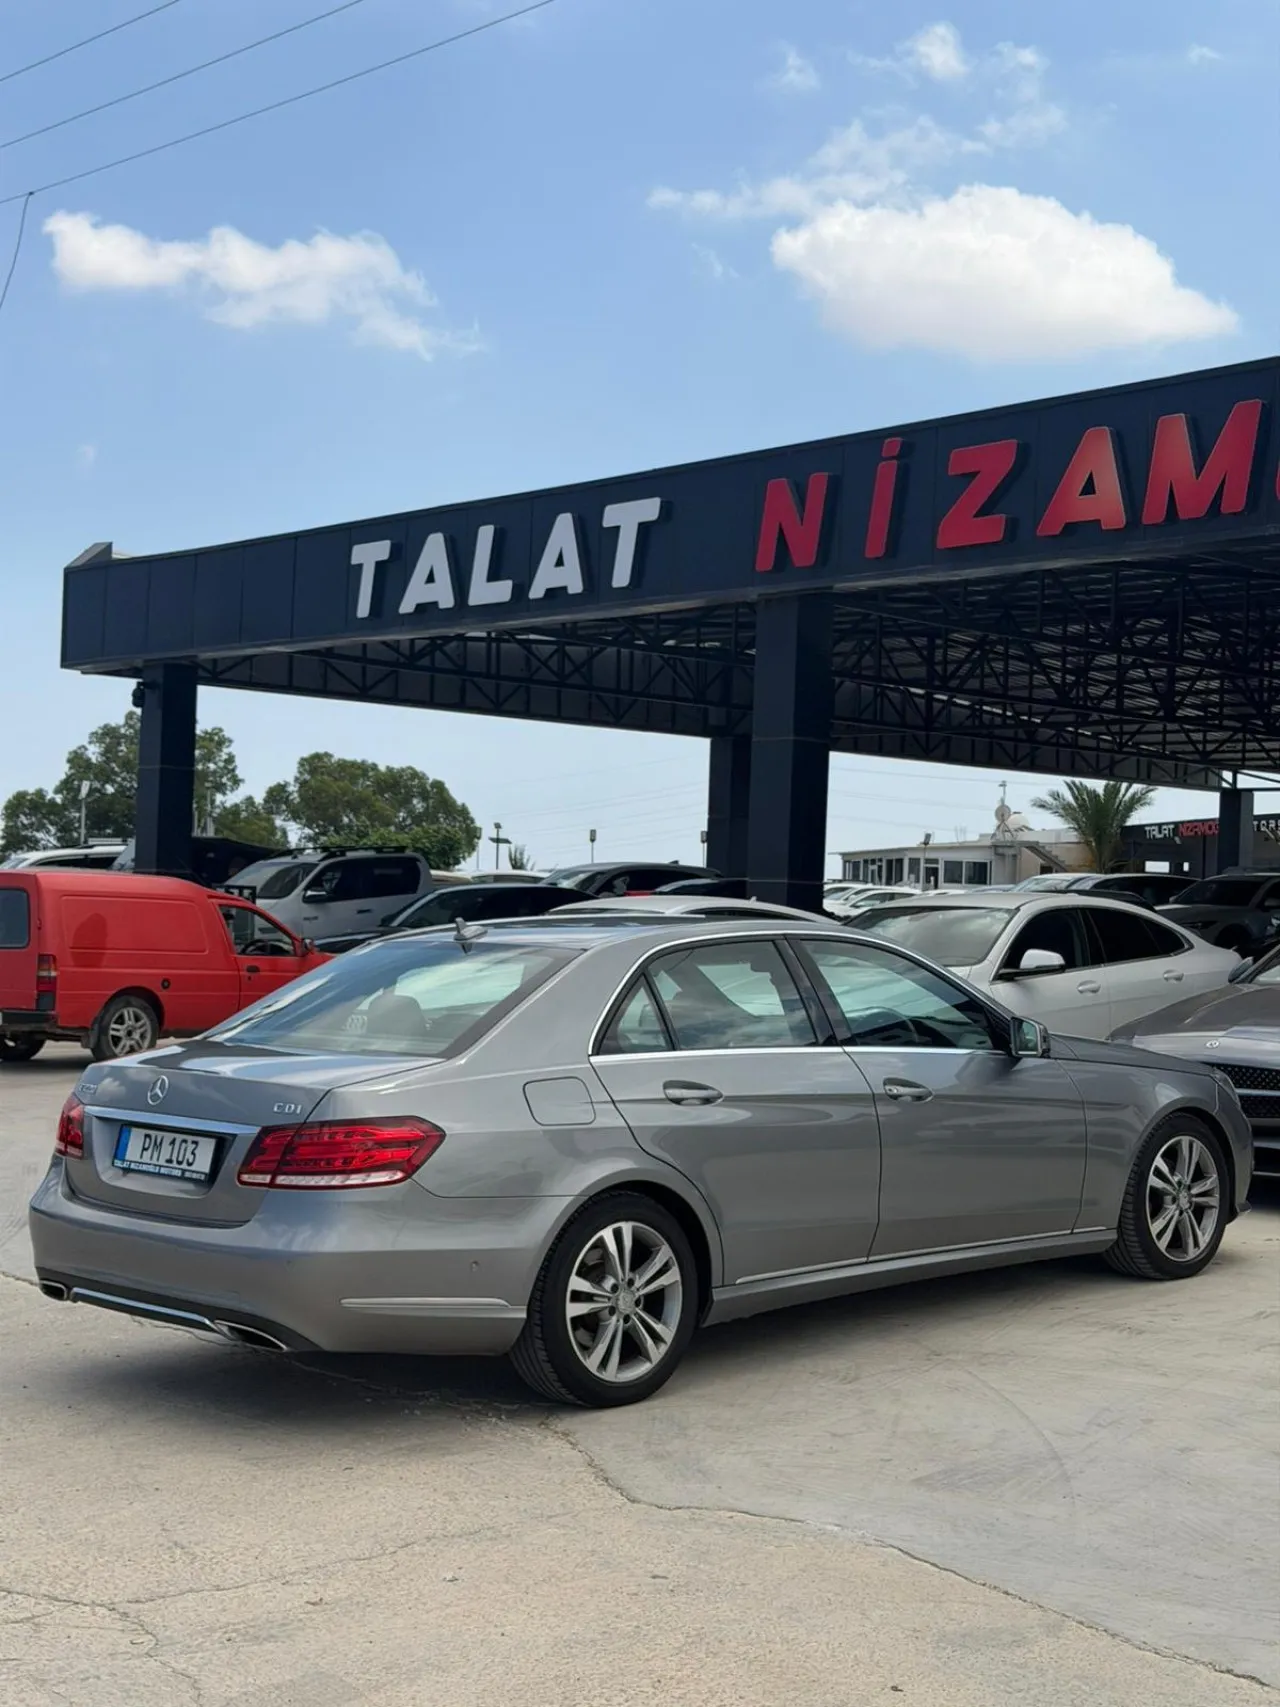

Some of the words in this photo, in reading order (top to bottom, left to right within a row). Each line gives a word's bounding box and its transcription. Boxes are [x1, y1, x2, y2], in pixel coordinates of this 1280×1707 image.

[351, 497, 661, 618] TALAT
[755, 399, 1280, 572] NİZAM
[1145, 824, 1175, 839] TALAT
[273, 1102, 302, 1115] CDI
[140, 1133, 164, 1162] PM
[165, 1137, 199, 1167] 103
